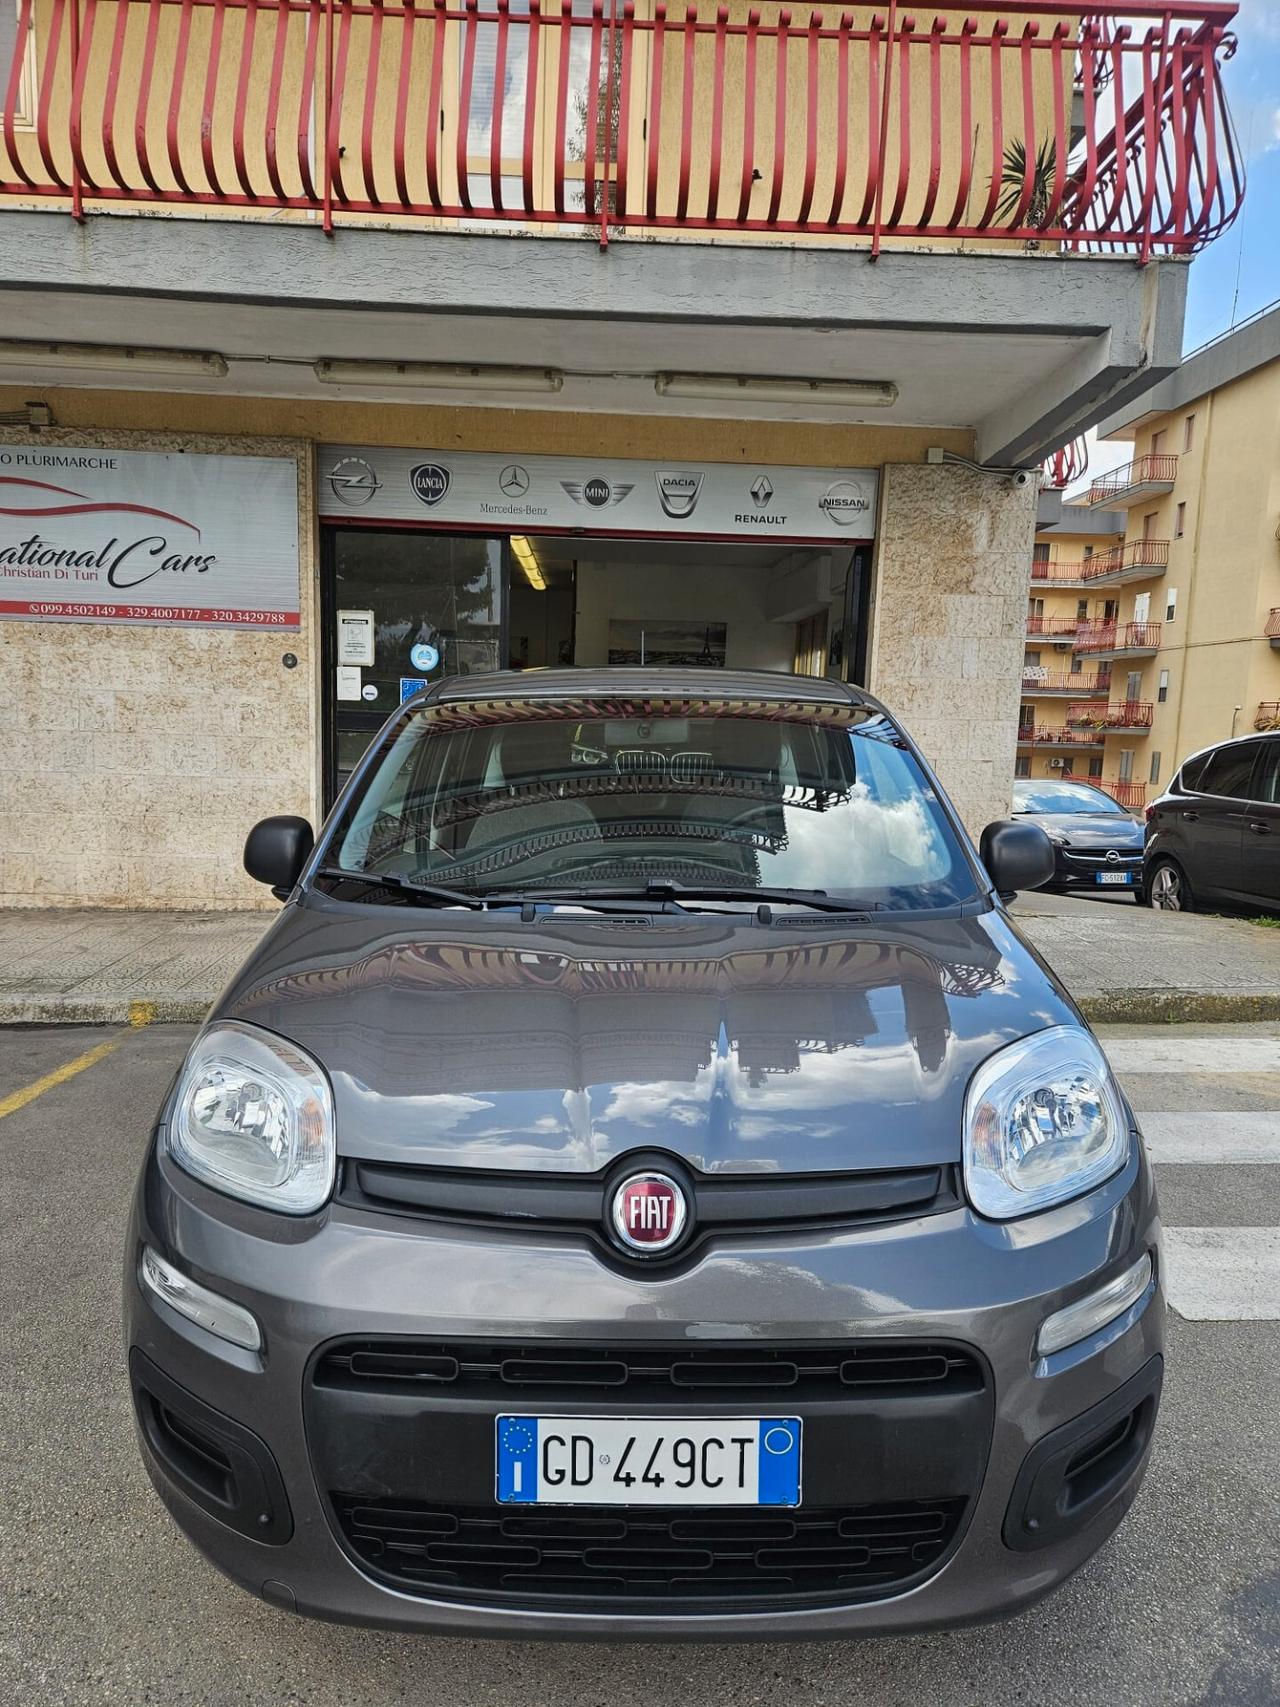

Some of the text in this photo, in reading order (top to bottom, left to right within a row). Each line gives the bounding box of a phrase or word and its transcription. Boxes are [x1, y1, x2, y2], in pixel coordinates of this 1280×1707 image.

[16, 454, 118, 470] PLURIMARCHE
[417, 477, 443, 490] LANCIA
[663, 478, 696, 488] DACIA
[585, 487, 609, 499] MINI
[823, 498, 866, 507] NISSAN
[480, 503, 549, 516] Mercedes-Benz
[734, 515, 787, 525] RENAULT
[107, 536, 219, 589] Cars
[55, 568, 69, 580] Di
[75, 569, 98, 581] Turi
[40, 604, 116, 616] 099.4502149
[127, 606, 200, 620] 329.4007177
[212, 610, 285, 624] 320.3429788
[630, 1195, 671, 1229] FIAT
[542, 1435, 754, 1488] GD 449CT
[513, 1461, 522, 1492] I
